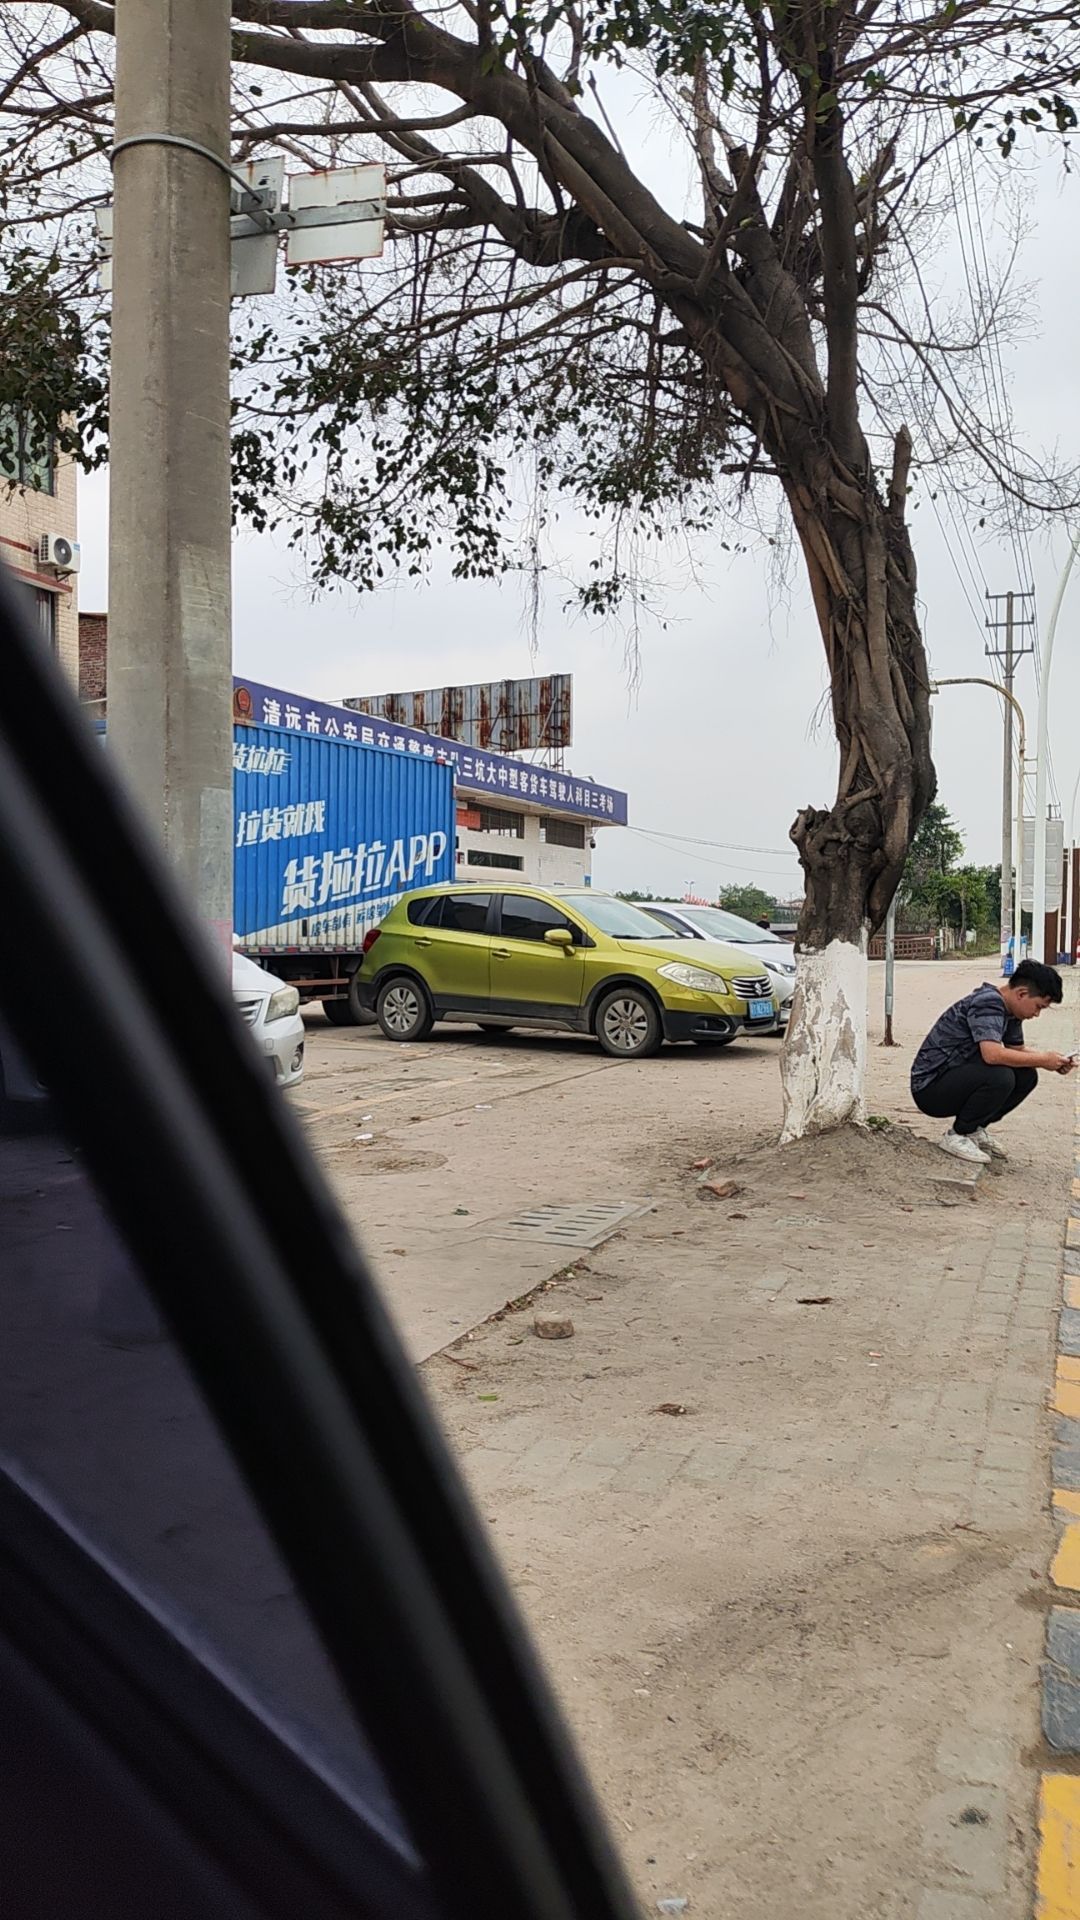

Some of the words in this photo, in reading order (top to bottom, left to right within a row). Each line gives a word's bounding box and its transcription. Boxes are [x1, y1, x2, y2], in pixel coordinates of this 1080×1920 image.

[236, 800, 326, 848] 拉货就找
[280, 830, 448, 917] 货拉拉APP
